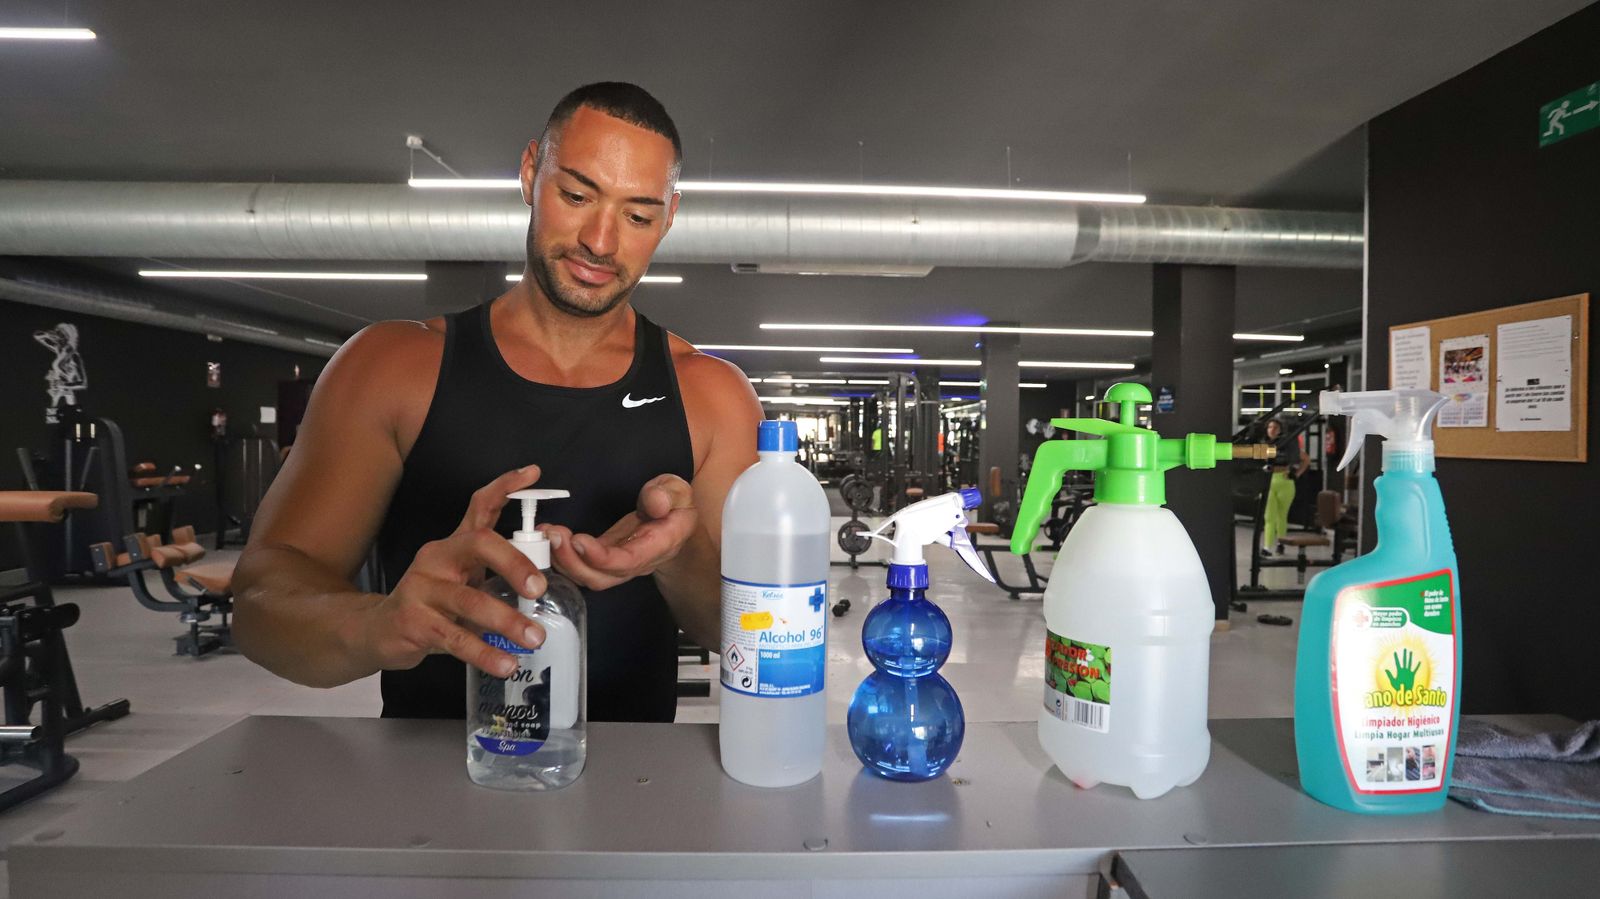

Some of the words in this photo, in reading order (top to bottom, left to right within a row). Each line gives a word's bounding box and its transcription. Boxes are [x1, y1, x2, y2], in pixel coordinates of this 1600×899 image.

[759, 630, 805, 643] Alcohol
[1364, 688, 1393, 709] ano
[1396, 683, 1414, 706] de
[1415, 685, 1447, 708] Santo
[1407, 714, 1440, 728] Higiénico
[1354, 730, 1384, 741] Limpia
[1387, 730, 1410, 741] Hogar
[1413, 728, 1444, 739] Multiusos
[498, 740, 517, 753] Spa
